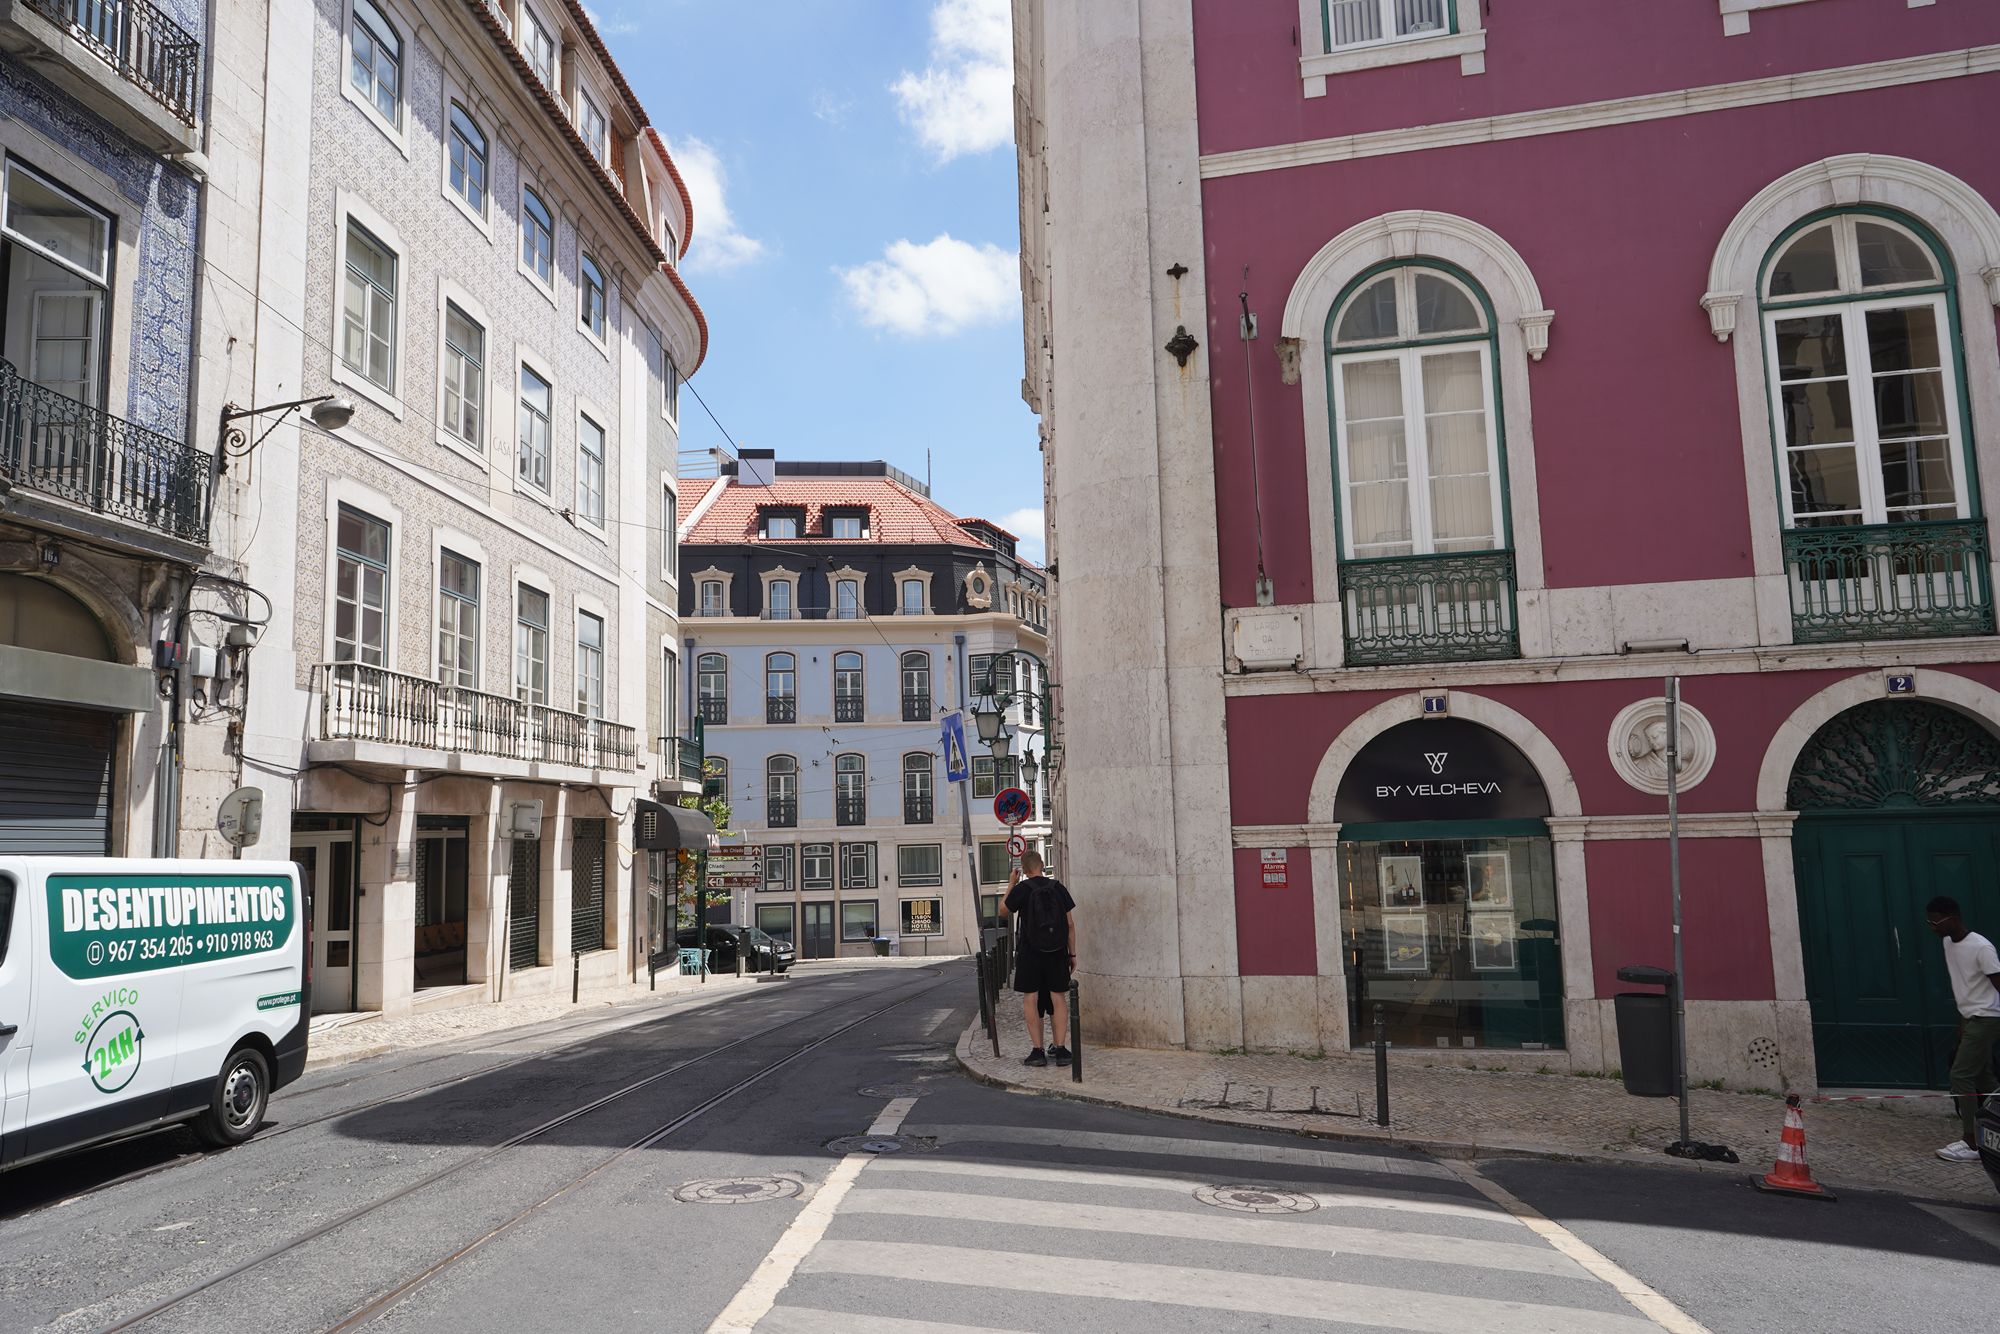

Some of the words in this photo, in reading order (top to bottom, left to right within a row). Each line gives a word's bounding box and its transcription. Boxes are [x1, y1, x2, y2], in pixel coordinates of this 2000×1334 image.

[1254, 621, 1280, 630] LARGO
[1262, 635, 1272, 643] DA
[1896, 677, 1906, 691] 2
[1431, 698, 1438, 711] 1
[1376, 785, 1401, 797] BY
[1406, 782, 1502, 796] VELCHEVA
[62, 886, 286, 932] DESENTUPIMENTOS
[108, 940, 136, 963] 967
[140, 938, 166, 959] 354
[169, 936, 194, 957] 205
[206, 932, 228, 953] 910
[231, 931, 251, 952] 918
[254, 930, 273, 949] 963
[75, 987, 139, 1044] SERVIÇO
[93, 1026, 135, 1080] 24H
